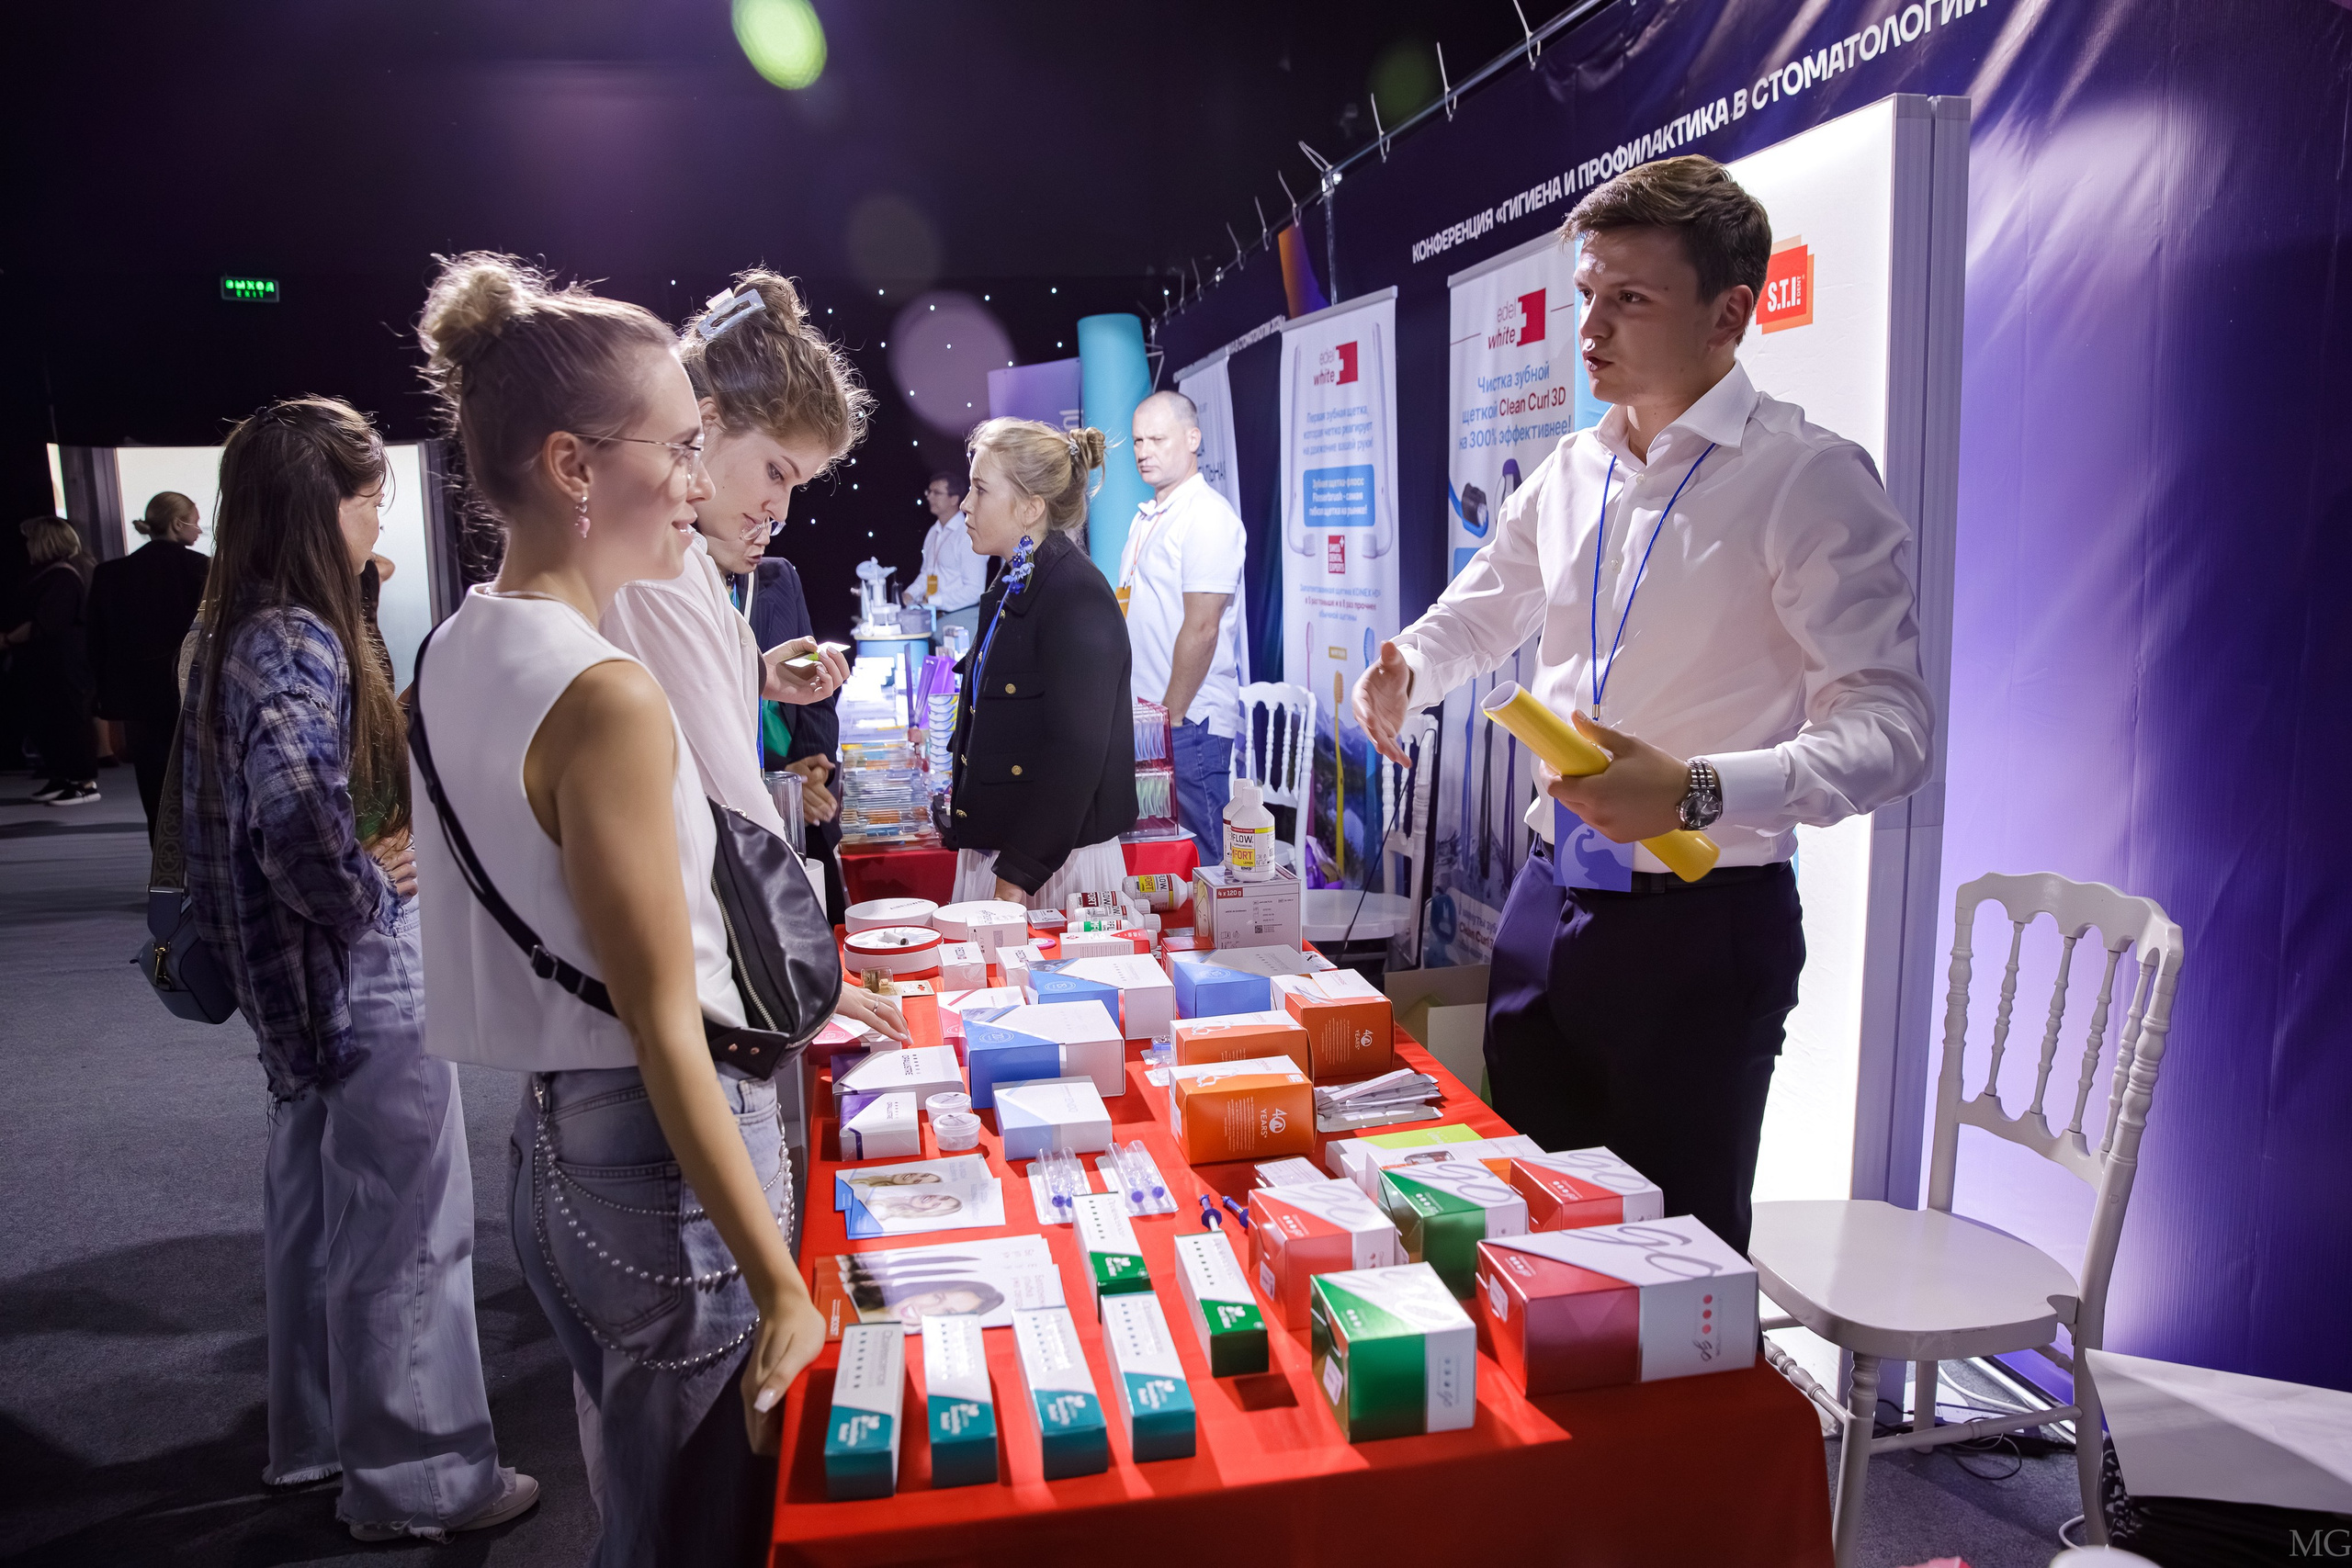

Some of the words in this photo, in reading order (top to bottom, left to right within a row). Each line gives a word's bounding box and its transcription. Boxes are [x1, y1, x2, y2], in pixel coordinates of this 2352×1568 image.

[1412, 208, 1494, 264] КОНФЕРЕНЦИЯ
[1496, 175, 1562, 223] «ГИГИЕНА
[1564, 169, 1576, 197] И
[1577, 97, 1729, 189] ПРОФИЛАКТИКА
[1733, 88, 1747, 121] В
[225, 279, 275, 293] ВЫХОД
[236, 289, 264, 299] EXIT
[1497, 299, 1516, 322] edel
[1487, 327, 1516, 350] white
[1313, 368, 1336, 386] white
[1477, 373, 1512, 393] Чистка
[1514, 360, 1550, 389] зубной
[1462, 400, 1498, 424] щеткой
[1499, 397, 1526, 416] Clean
[1528, 389, 1550, 412] Curl
[1551, 386, 1566, 407] 3D
[1459, 435, 1467, 450] на
[1470, 427, 1497, 448] 300%
[1498, 414, 1572, 447] эффективнее!
